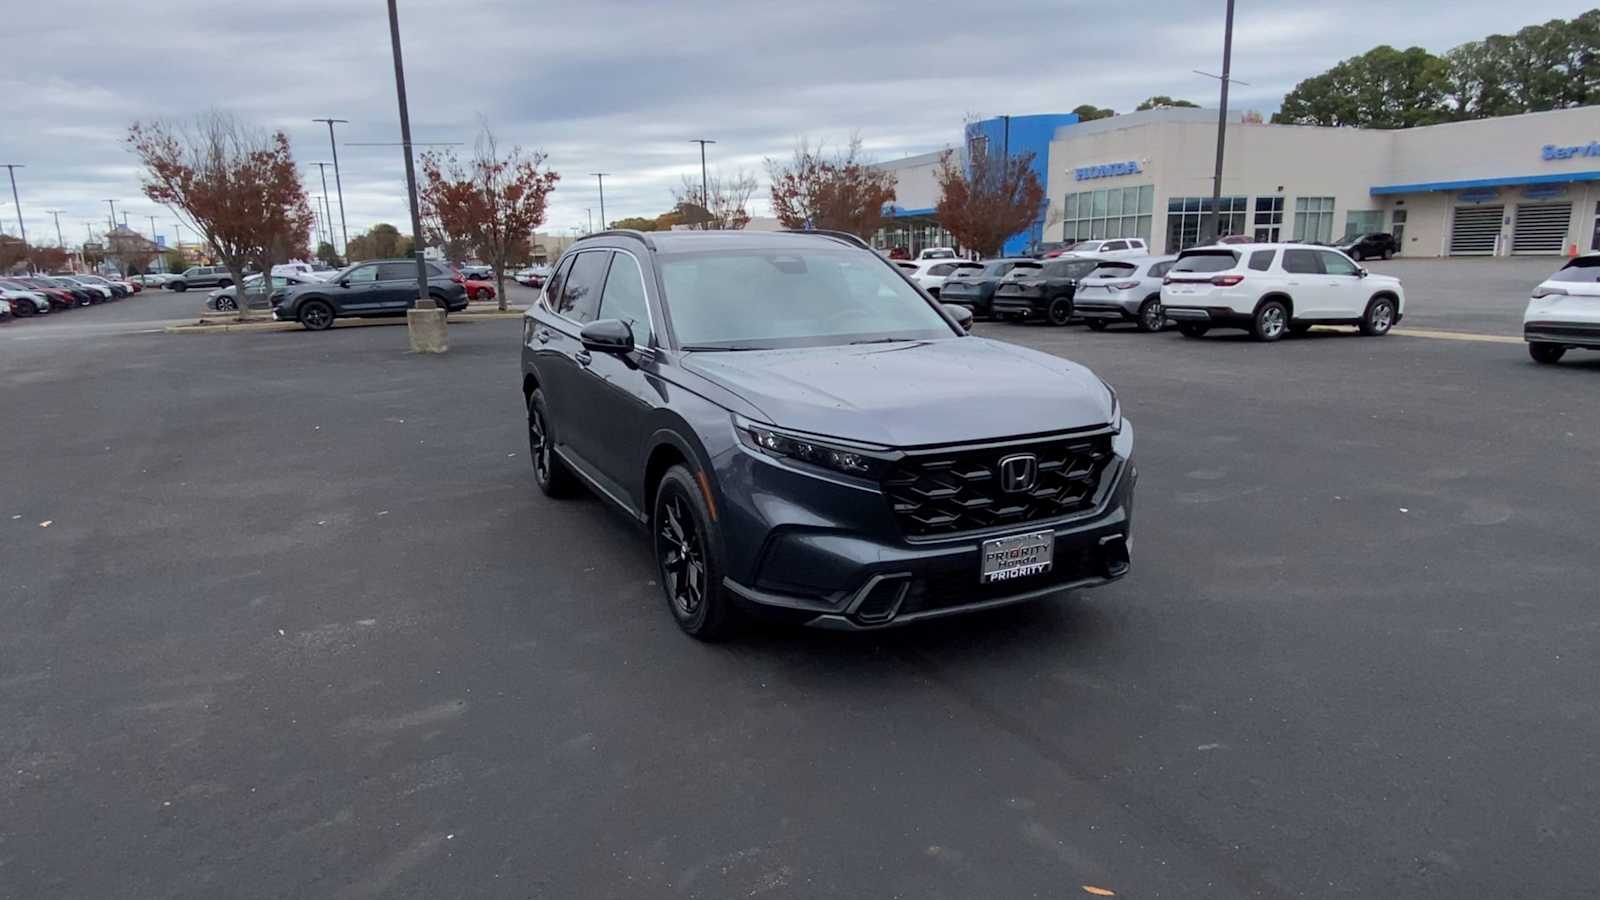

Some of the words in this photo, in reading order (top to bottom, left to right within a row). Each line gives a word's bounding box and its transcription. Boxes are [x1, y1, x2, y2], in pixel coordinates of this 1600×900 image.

[1075, 161, 1142, 181] HONDA
[986, 544, 1050, 562] PRIORITY
[999, 556, 1037, 569] Honda
[990, 565, 1044, 582] PRIORITY
